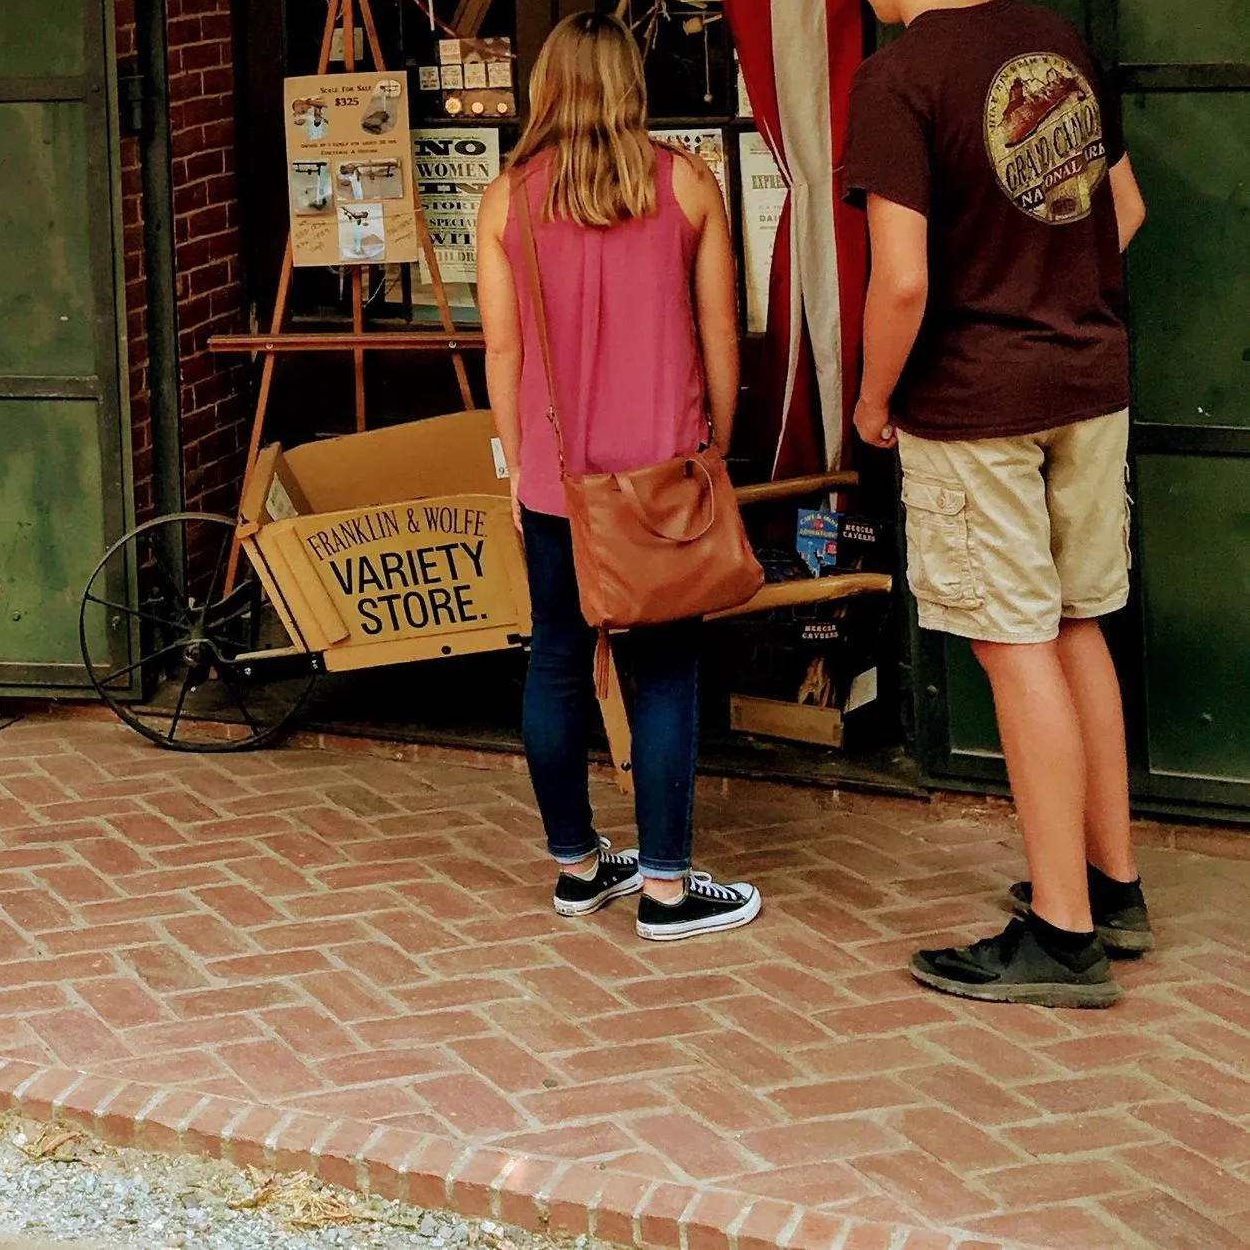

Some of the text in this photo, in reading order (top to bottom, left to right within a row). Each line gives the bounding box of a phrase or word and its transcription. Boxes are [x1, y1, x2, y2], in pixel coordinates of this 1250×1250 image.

[335, 97, 360, 107] $325
[414, 140, 487, 156] NO
[416, 163, 489, 178] WOMEN
[418, 182, 488, 194] IN
[752, 174, 785, 189] EXPRE
[430, 233, 475, 244] WIT
[306, 507, 488, 561] FRANKLIN & WOLFE.
[329, 540, 484, 596] VARIETY
[357, 584, 488, 636] STORE.
